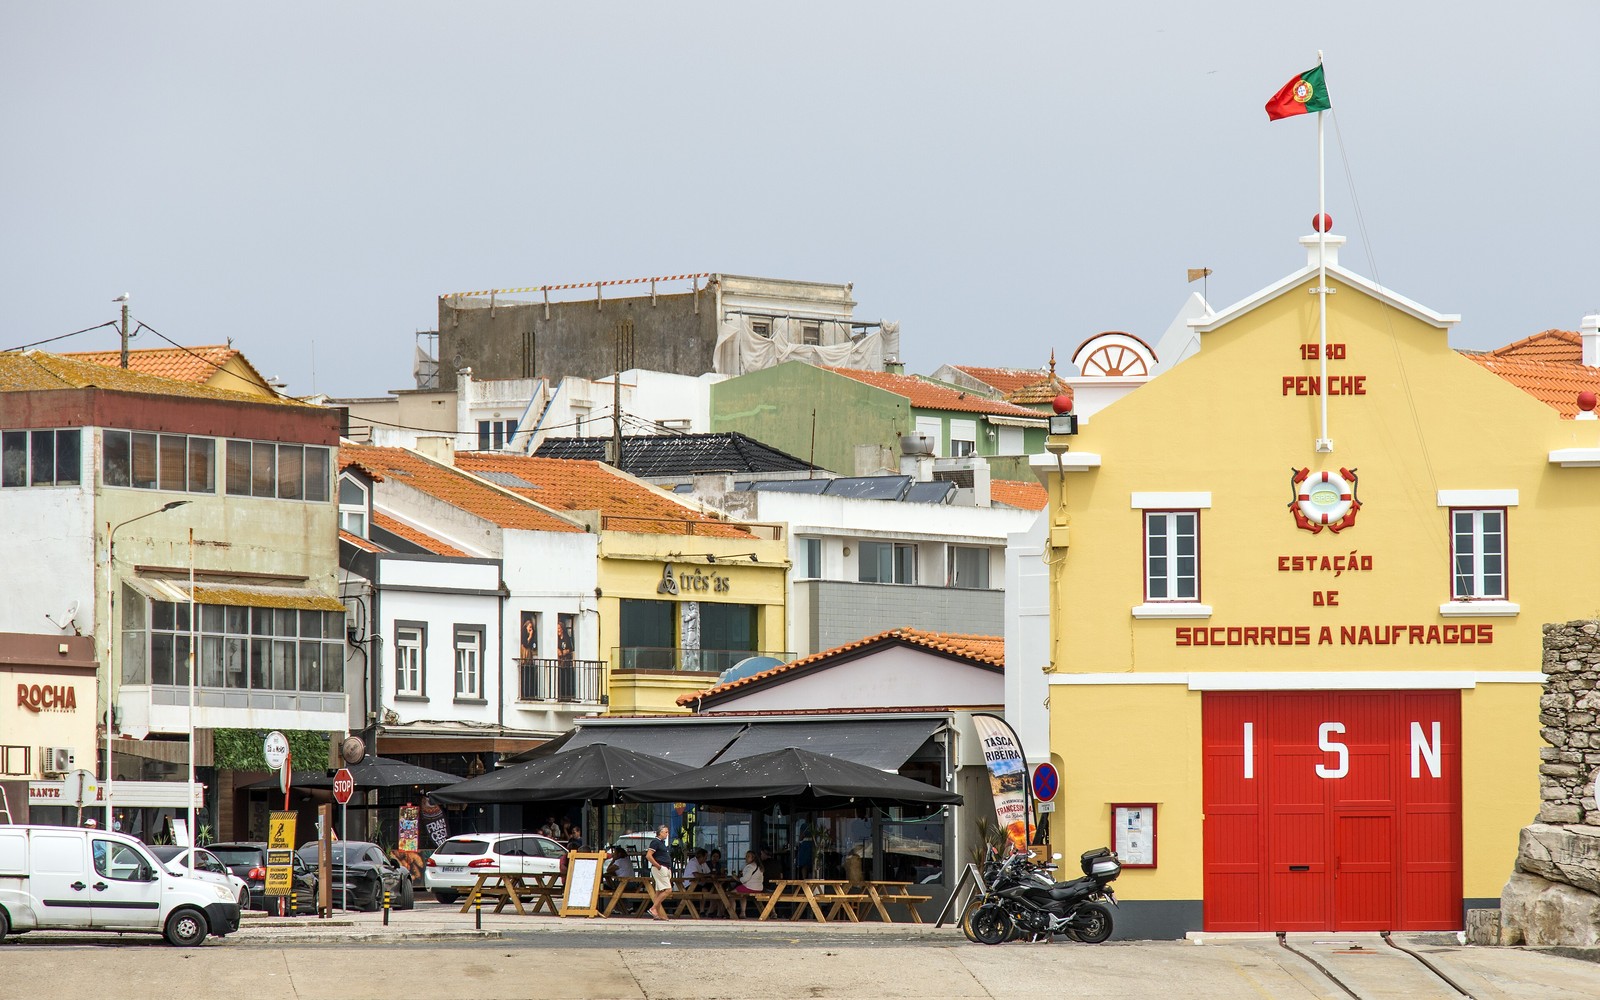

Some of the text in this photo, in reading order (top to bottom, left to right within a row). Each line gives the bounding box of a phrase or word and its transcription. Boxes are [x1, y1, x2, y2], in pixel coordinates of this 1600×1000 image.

[1299, 343, 1346, 360] 1940
[1282, 376, 1367, 396] PENCHE
[1278, 549, 1373, 578] ESTAÇÃO
[1312, 590, 1339, 606] DE
[1175, 624, 1493, 646] SOCORROS A NAUFRAGOS
[17, 683, 77, 713] ROCHA
[984, 736, 1014, 748] TASCA
[985, 749, 1021, 762] RIBEIRA
[334, 780, 351, 793] STOP
